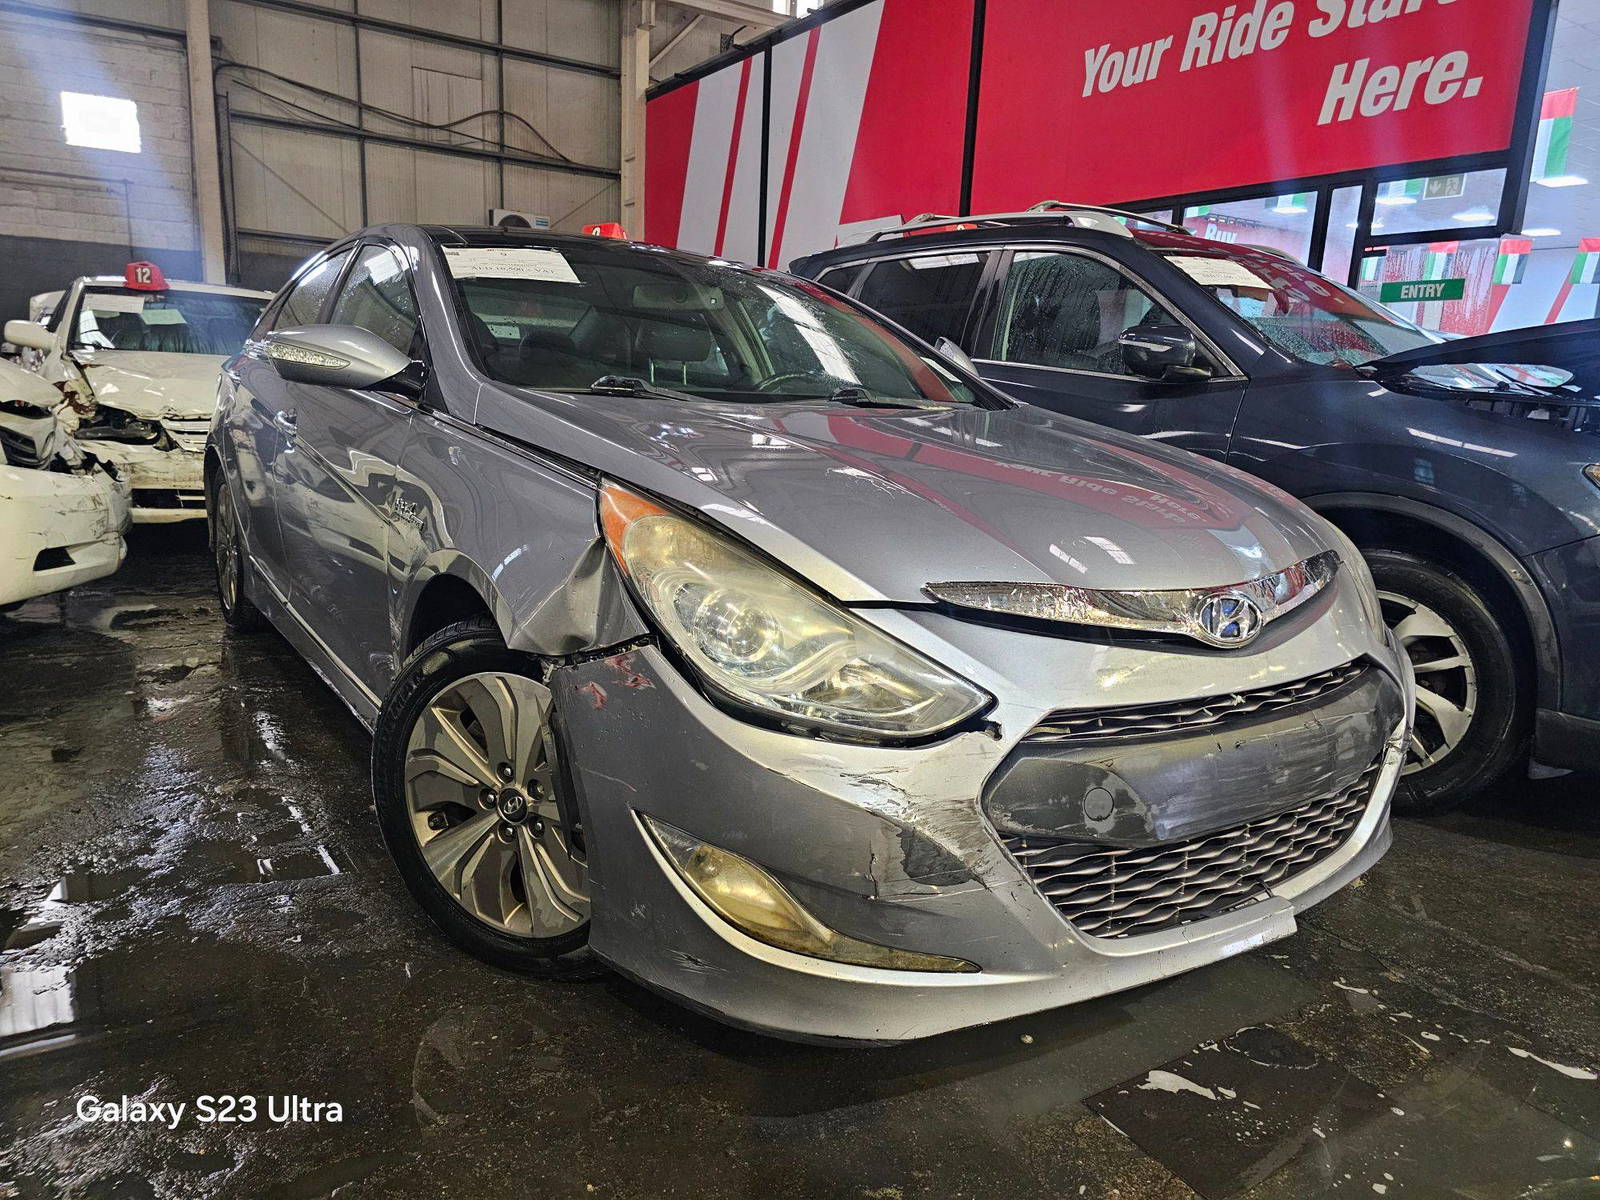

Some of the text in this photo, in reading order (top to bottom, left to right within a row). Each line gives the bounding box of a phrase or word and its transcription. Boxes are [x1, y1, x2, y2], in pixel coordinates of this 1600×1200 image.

[1082, 0, 1457, 98] Your Ride Sta
[1317, 50, 1483, 126] Here.
[136, 267, 151, 283] 12
[1400, 283, 1445, 299] ENTRY
